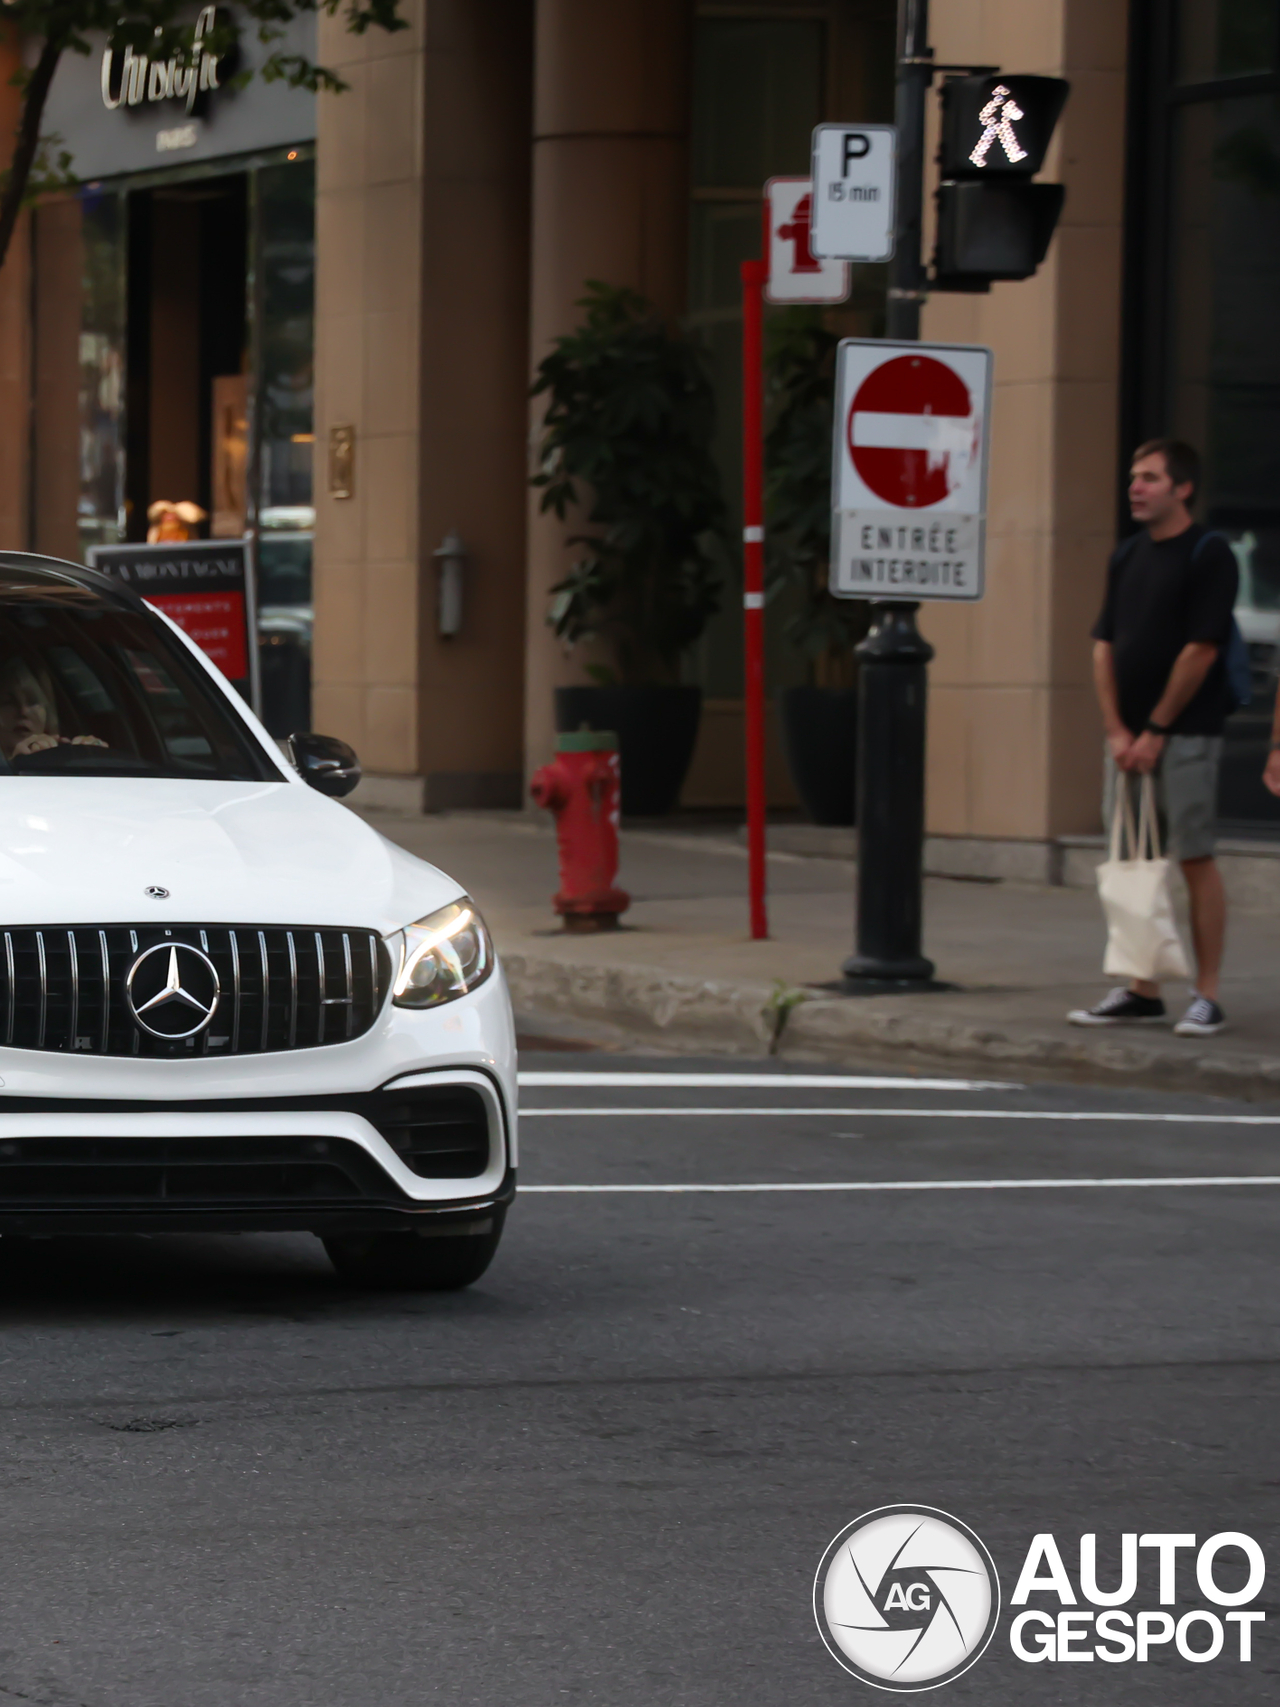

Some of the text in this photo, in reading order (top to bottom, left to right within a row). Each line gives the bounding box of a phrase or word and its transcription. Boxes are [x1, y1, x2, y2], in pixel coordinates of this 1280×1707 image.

[842, 133, 871, 178] P
[828, 182, 880, 201] 15 min
[861, 521, 957, 553] ENTRÉE
[851, 558, 966, 587] INTERDITE
